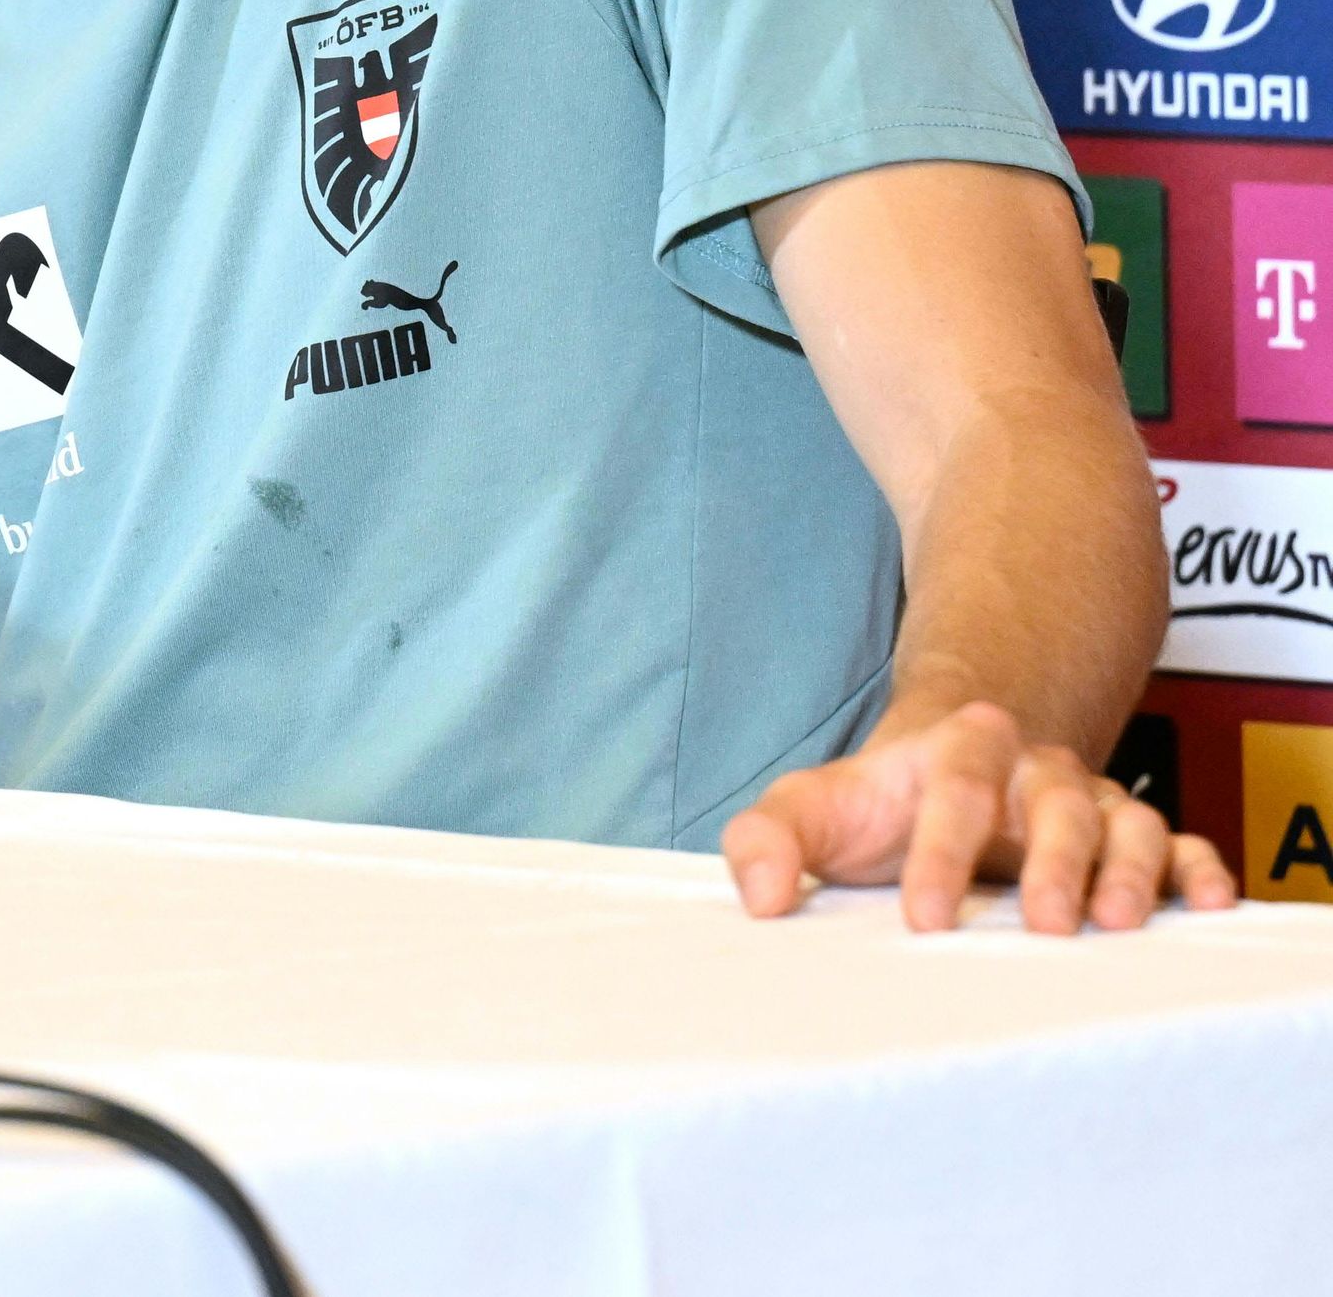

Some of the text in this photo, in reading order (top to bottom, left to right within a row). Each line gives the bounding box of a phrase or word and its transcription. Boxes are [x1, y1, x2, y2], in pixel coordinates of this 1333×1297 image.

[317, 2, 430, 50] SEIT ÖFB 1904
[1083, 68, 1309, 123] HYUNDAI
[284, 321, 431, 401] PUMA
